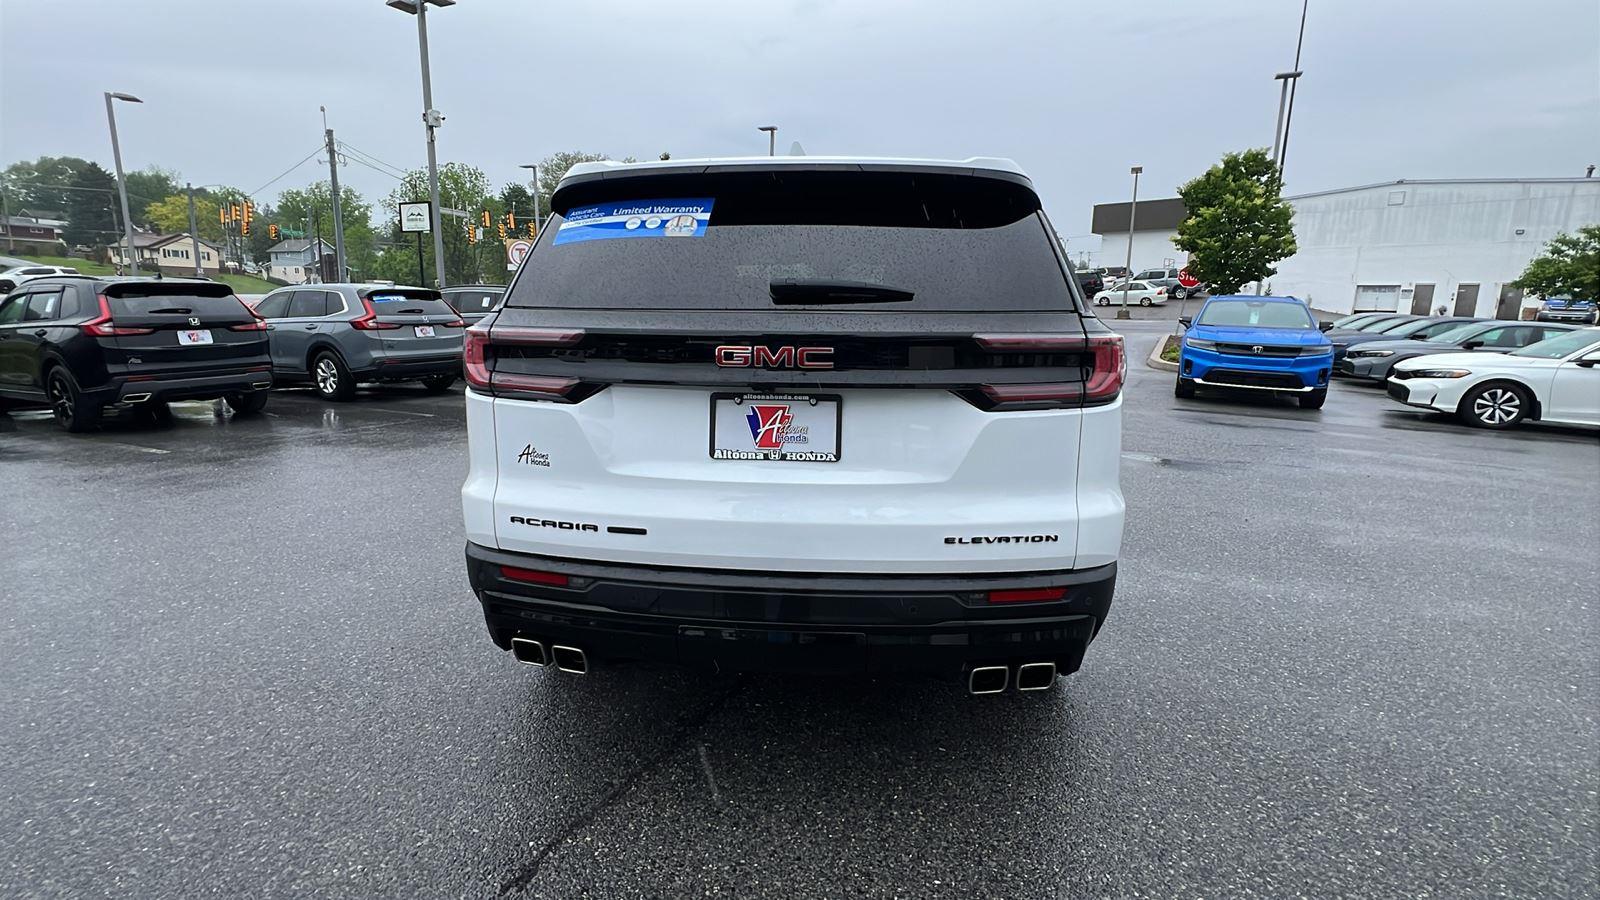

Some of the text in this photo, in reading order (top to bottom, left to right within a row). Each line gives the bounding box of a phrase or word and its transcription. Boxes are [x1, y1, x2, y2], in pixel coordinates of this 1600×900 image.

[570, 207, 598, 216] Assurant
[612, 205, 704, 216] Limited Warranty
[715, 345, 835, 369] GMC
[743, 393, 810, 401] altoonahonda.com
[756, 409, 808, 443] Altoona
[777, 432, 808, 443] Honda
[518, 443, 549, 464] Altoona
[713, 449, 837, 461] Altoona HONDA
[530, 457, 551, 467] Honda
[510, 516, 599, 533] ACADIA
[943, 534, 1059, 545] ELEVATION
